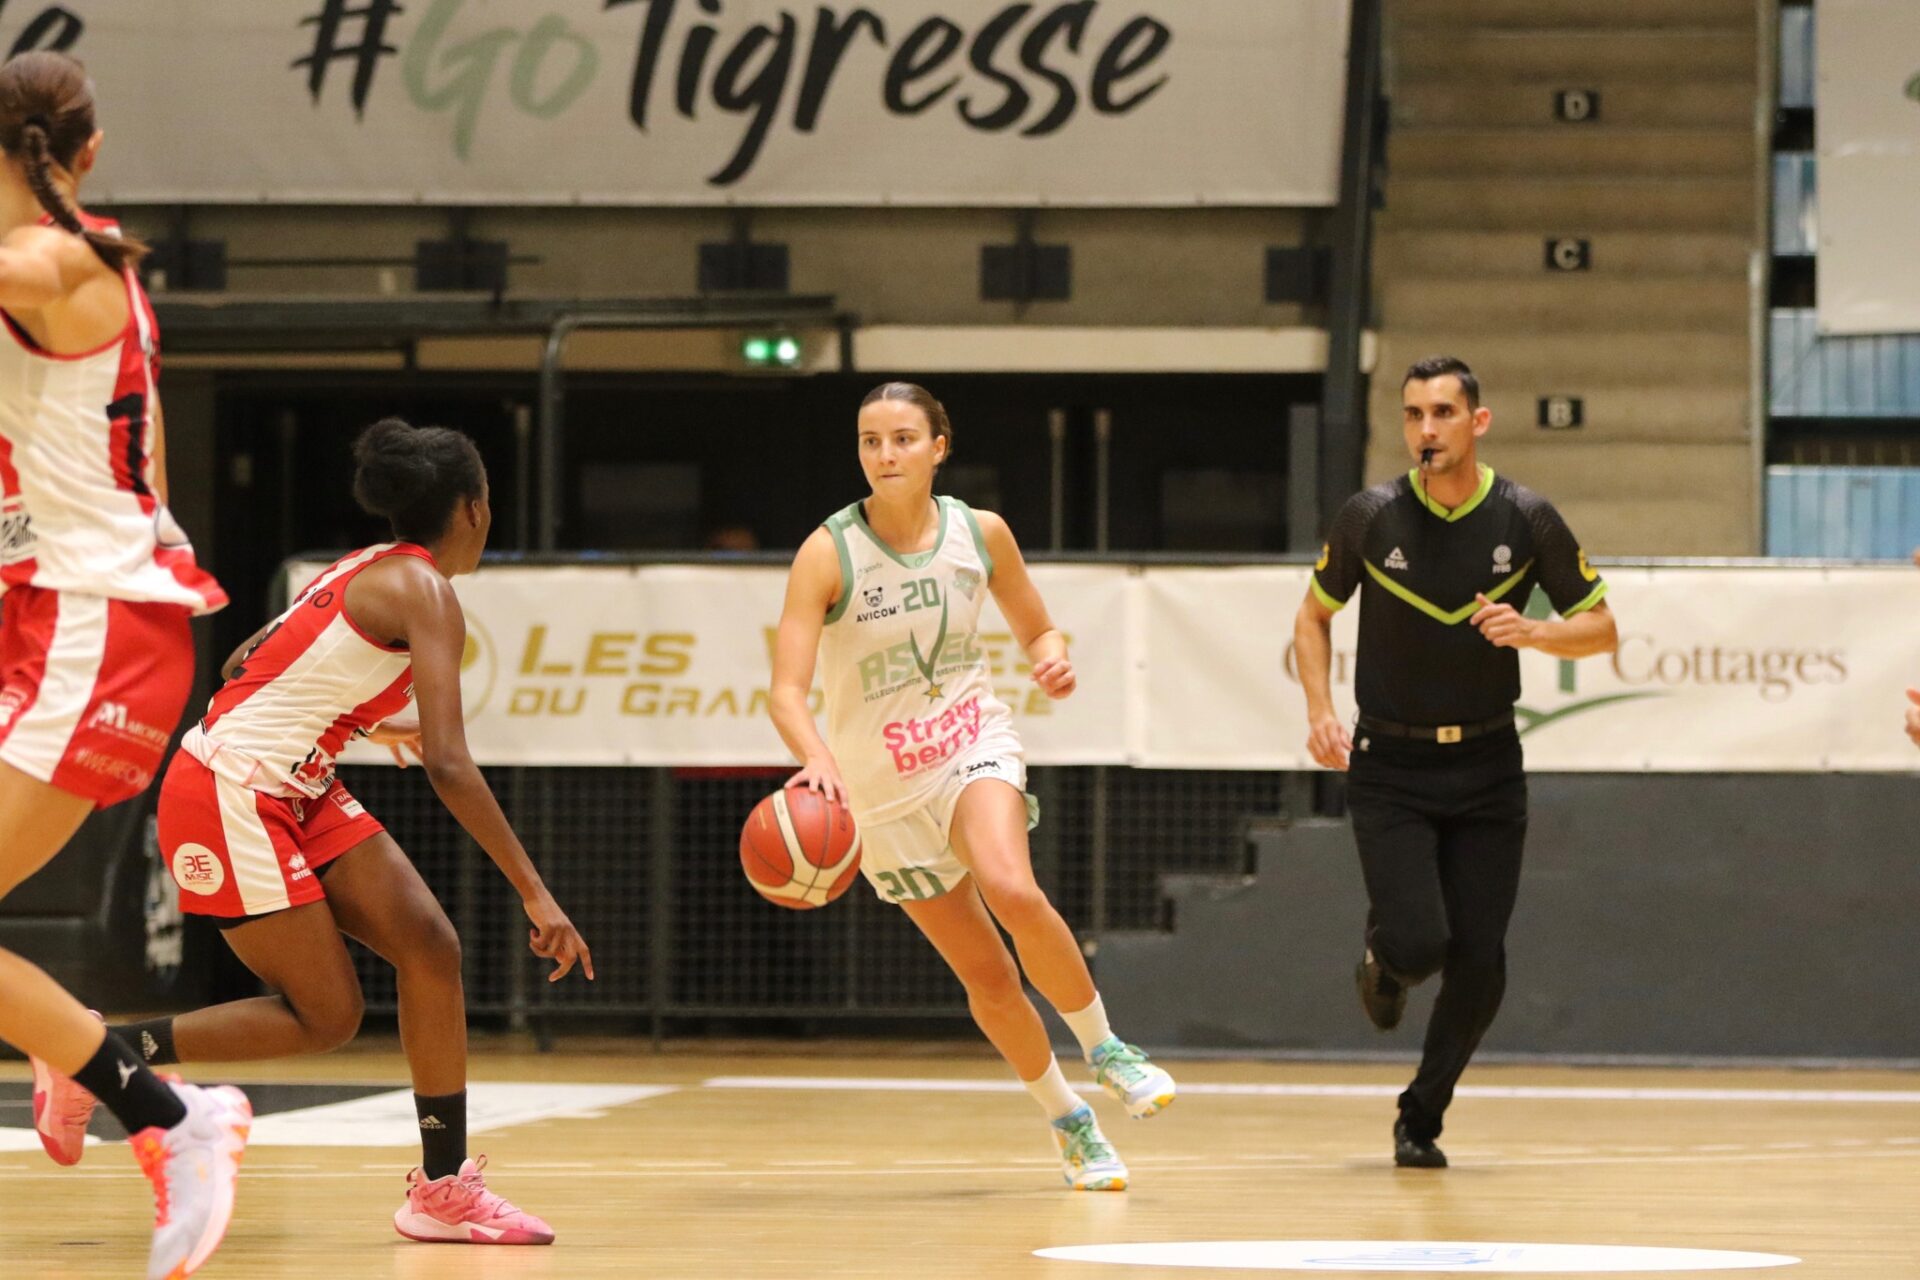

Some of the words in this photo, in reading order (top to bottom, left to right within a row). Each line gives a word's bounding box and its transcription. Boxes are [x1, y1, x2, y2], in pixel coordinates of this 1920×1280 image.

[1384, 559, 1408, 571] PEAK
[856, 605, 898, 623] AVICOM
[901, 577, 941, 613] 20
[517, 624, 697, 677] LES
[1611, 635, 1849, 698] Cottages
[507, 687, 587, 717] DU
[883, 696, 980, 751] Straw
[892, 722, 980, 773] berry
